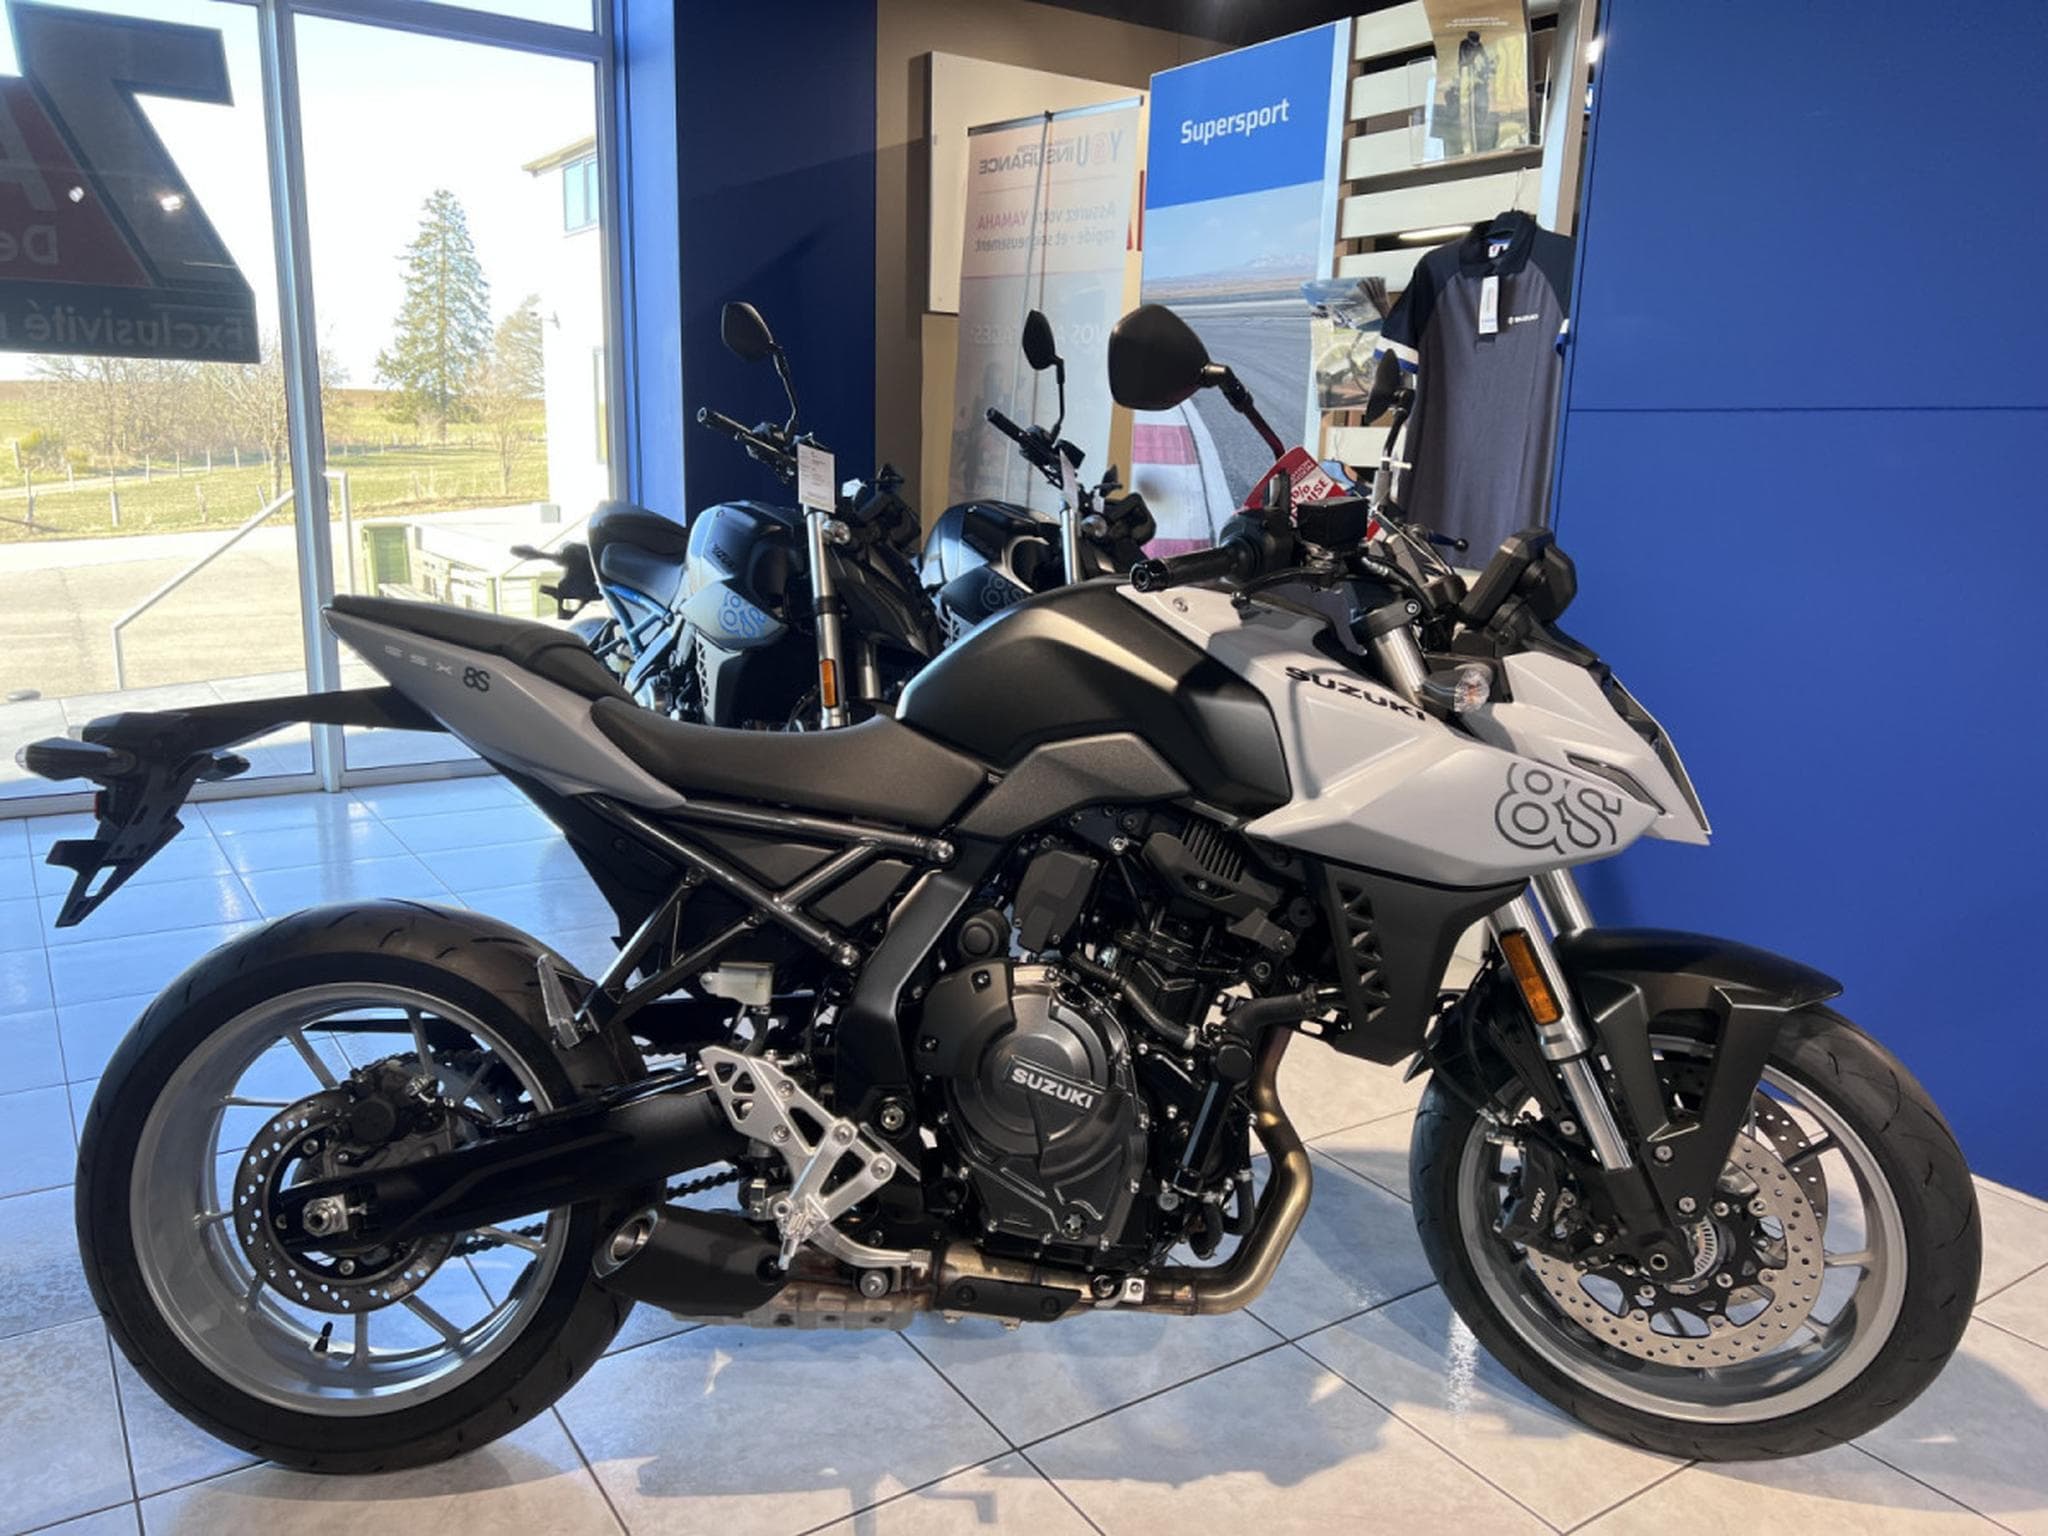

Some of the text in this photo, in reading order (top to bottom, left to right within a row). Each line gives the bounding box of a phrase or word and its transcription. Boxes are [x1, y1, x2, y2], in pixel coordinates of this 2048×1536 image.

[1180, 97, 1290, 146] Supersport
[463, 666, 491, 693] 8S
[1285, 666, 1426, 722] SUZUKI
[1011, 1067, 1094, 1109] SUZUKI
